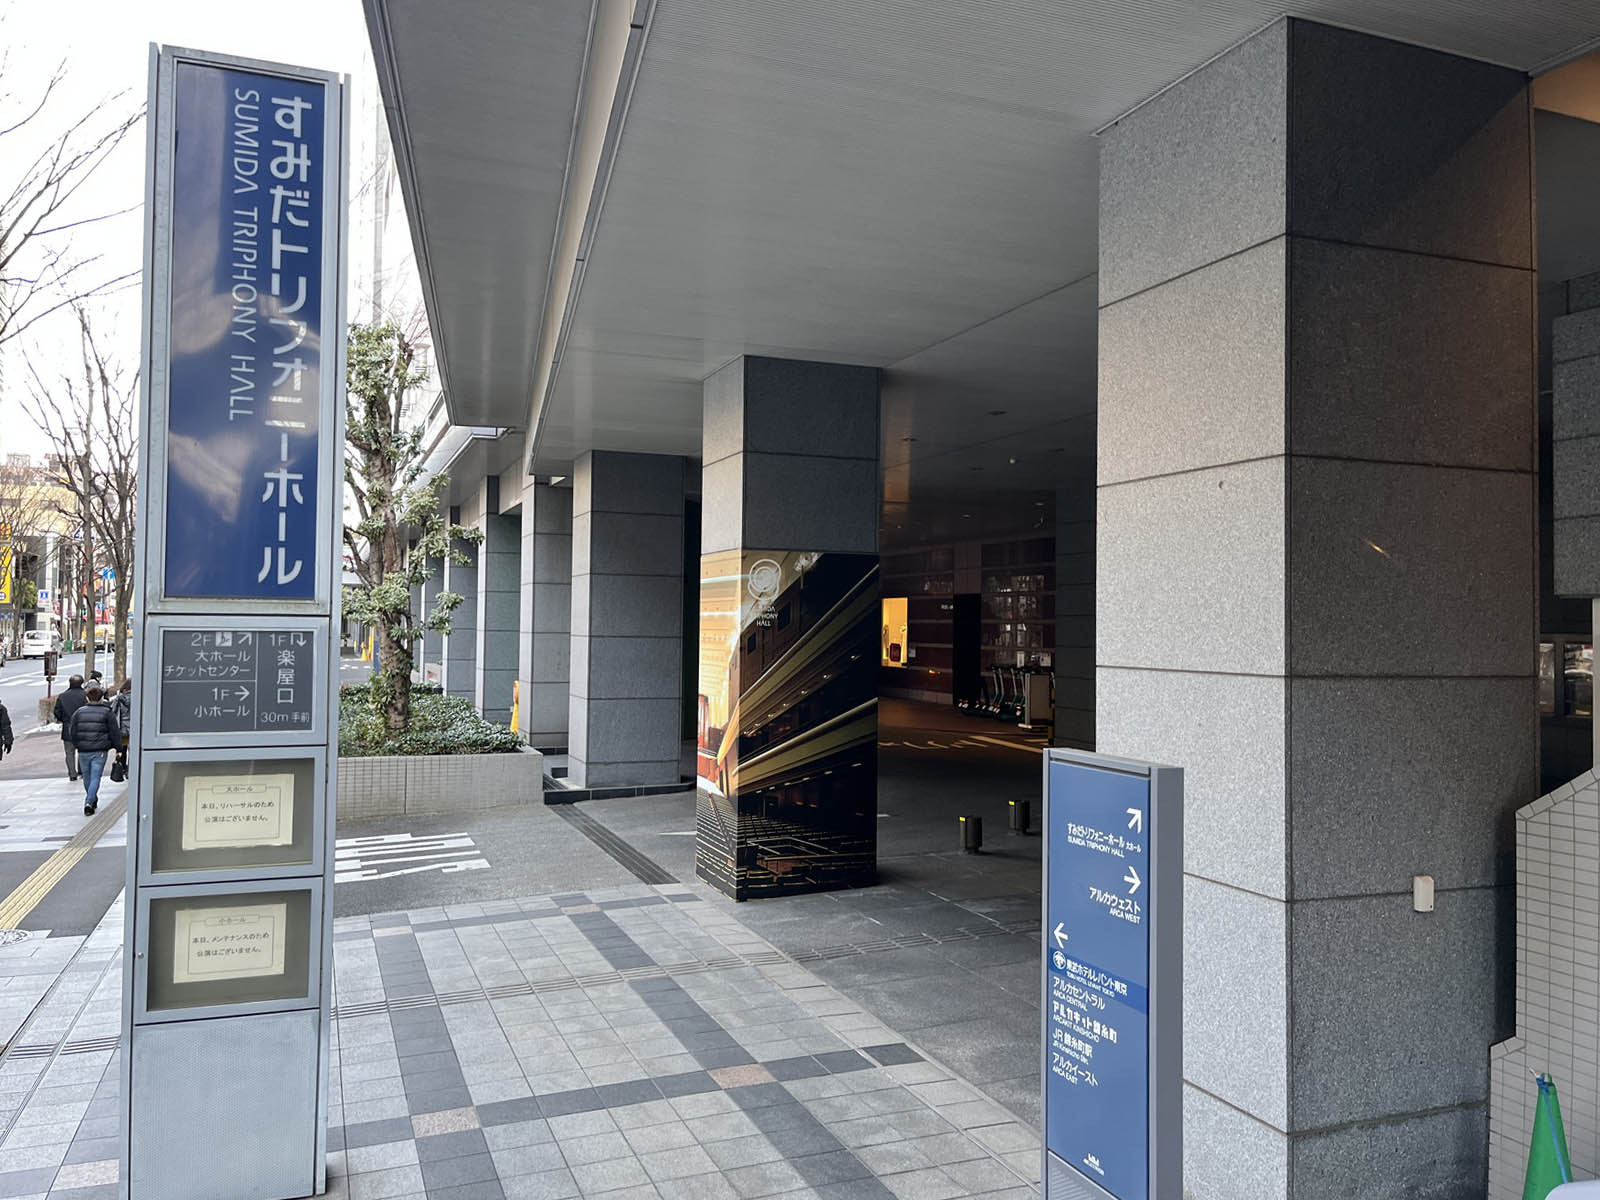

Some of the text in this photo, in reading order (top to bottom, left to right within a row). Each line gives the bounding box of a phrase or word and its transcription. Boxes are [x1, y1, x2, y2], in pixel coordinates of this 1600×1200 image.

[229, 88, 260, 421] SUMIDA TRIPHONY HALL
[258, 96, 312, 585] すみだトリフォニーホール
[191, 632, 212, 647] 2F
[270, 633, 287, 647] 1F
[195, 650, 251, 663] 大ホール
[164, 665, 251, 678] チケットセンター
[276, 649, 296, 704] 楽屋口
[212, 687, 230, 701] 1F
[194, 705, 250, 718] 小ホール
[261, 712, 289, 723] 30m
[1124, 911, 1141, 925] WEST
[1053, 1052, 1099, 1087] アルカイースト
